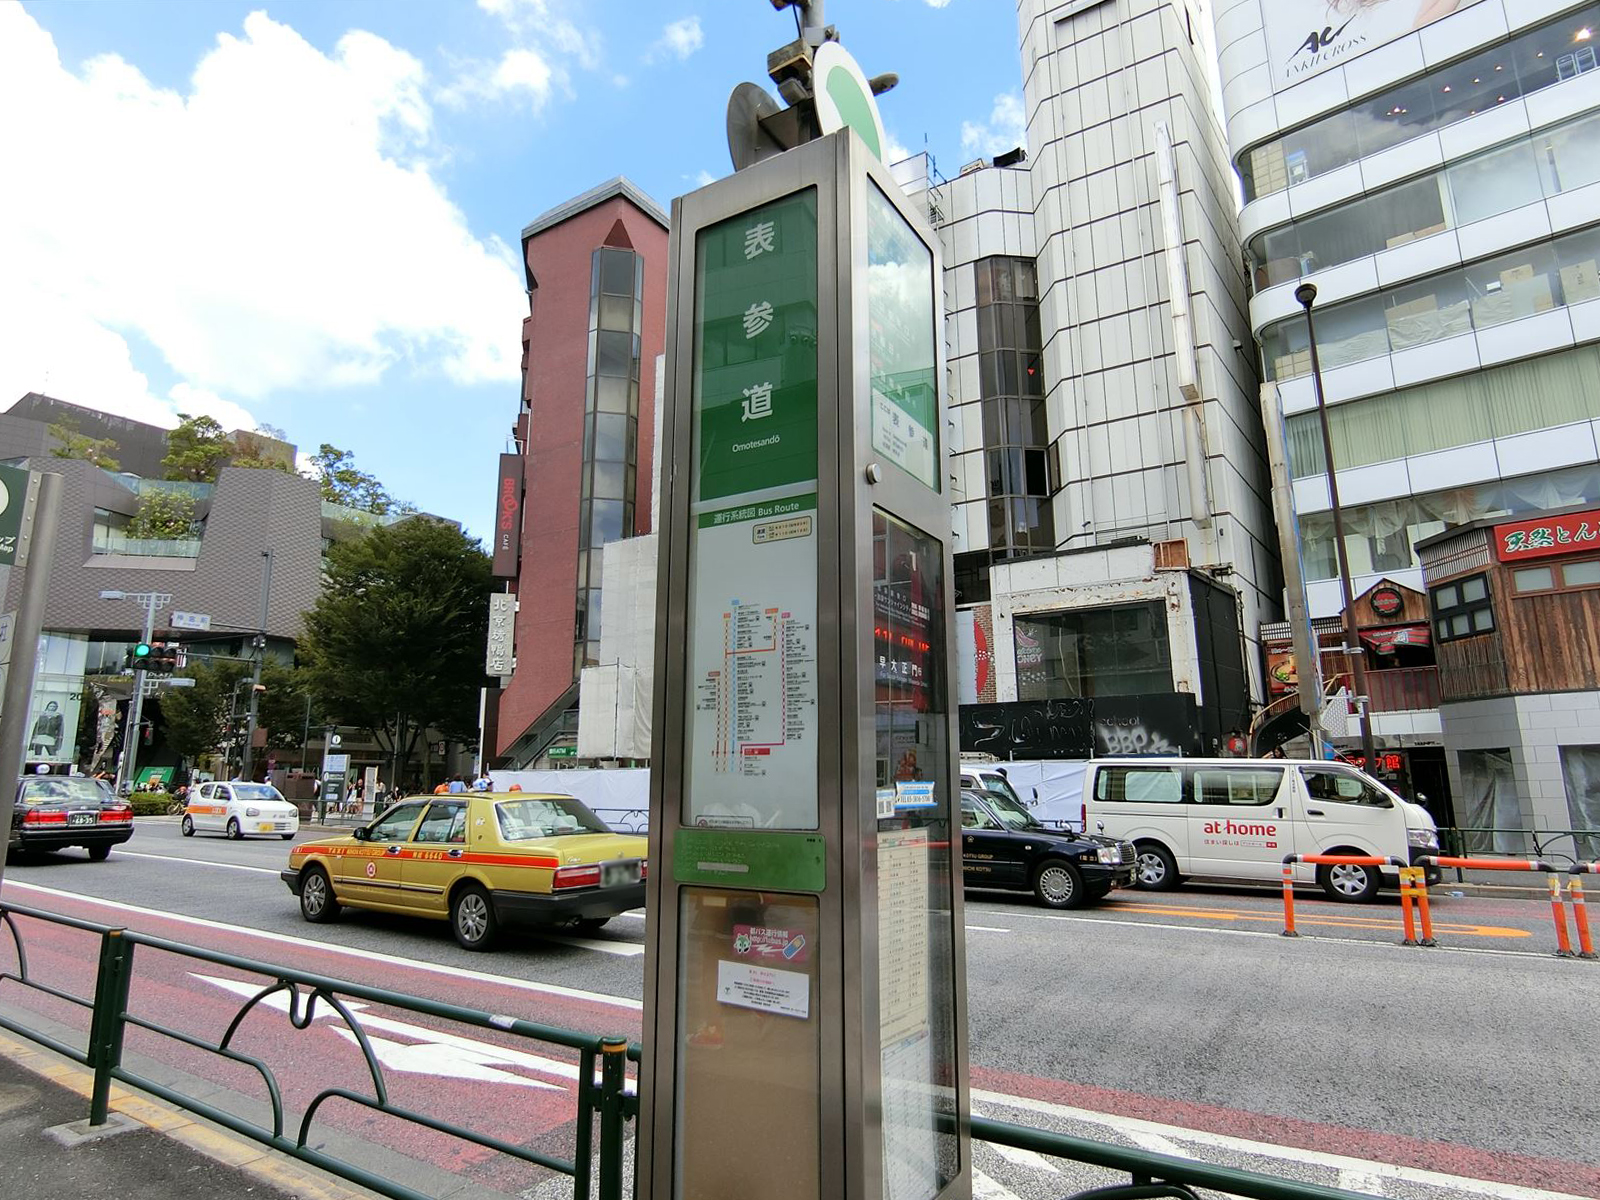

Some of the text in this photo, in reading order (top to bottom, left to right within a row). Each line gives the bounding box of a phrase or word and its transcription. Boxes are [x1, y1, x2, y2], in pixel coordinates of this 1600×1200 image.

[741, 221, 774, 423] 表参道
[732, 434, 780, 453] Omotesandō
[758, 502, 800, 516] Bus Route
[1504, 521, 1600, 552] 天然とん
[1226, 820, 1277, 836] home
